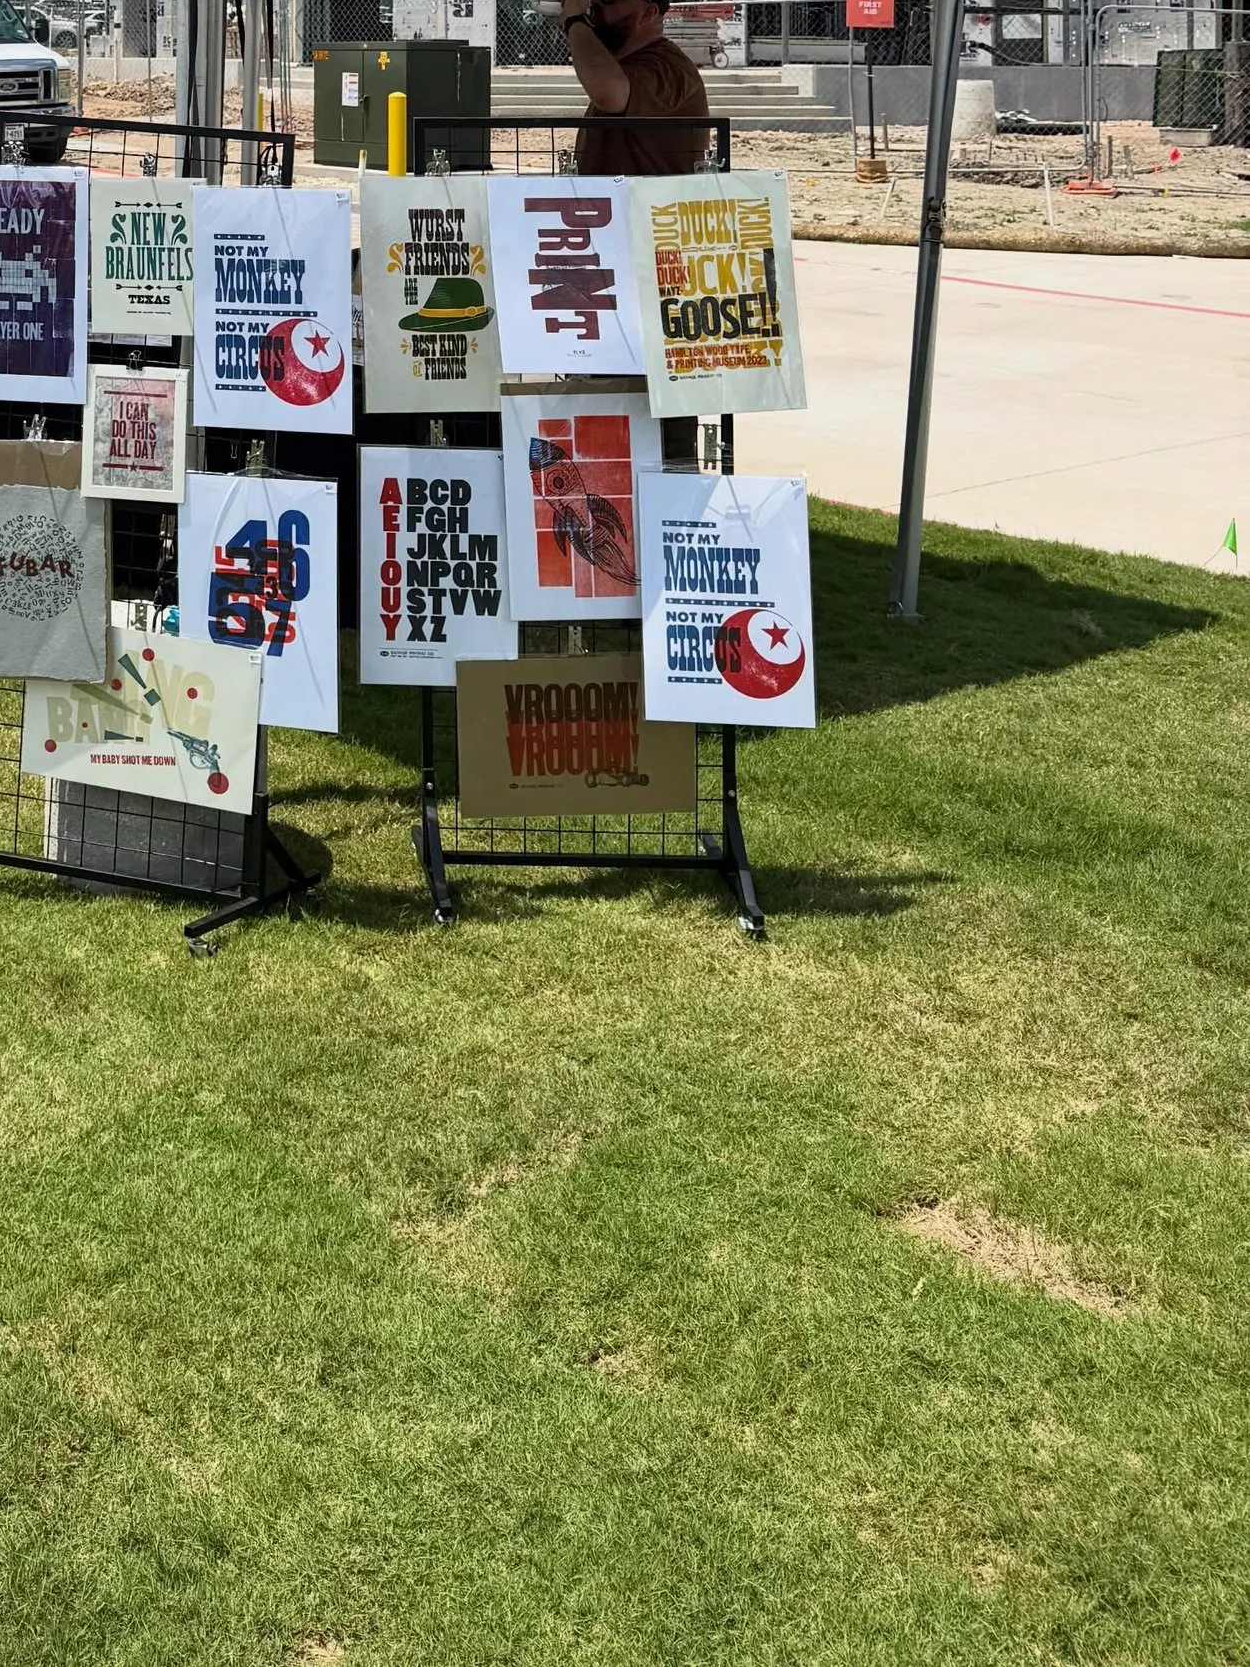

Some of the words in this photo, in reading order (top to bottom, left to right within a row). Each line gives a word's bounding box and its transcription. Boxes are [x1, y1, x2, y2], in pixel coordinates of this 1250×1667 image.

[130, 212, 168, 245] NEW
[408, 208, 465, 241] WURST
[105, 246, 194, 281] BRAUNFELS
[214, 245, 244, 257] NOT
[247, 246, 268, 257] MY
[404, 242, 470, 276] FRIENDS
[215, 259, 306, 305] MONKEY
[524, 198, 617, 340] PRINT
[128, 294, 170, 304] TEXAS
[404, 291, 419, 305] THE
[23, 322, 44, 341] ONE
[215, 321, 245, 332] NOT
[248, 322, 269, 333] MY
[215, 334, 285, 381] CIRCUS
[412, 334, 437, 357] BEST
[439, 334, 467, 357] KIND
[424, 357, 467, 380] FRIENDS
[119, 401, 125, 420] I
[126, 401, 149, 421] CAN
[112, 421, 127, 439] DO
[129, 421, 157, 440] THIS
[109, 441, 131, 458] ALL
[133, 441, 157, 460] DAY
[379, 478, 402, 504] A
[406, 479, 471, 505] BCD
[383, 506, 400, 532] E
[406, 506, 468, 533] FGH
[407, 534, 498, 561] JKLM
[663, 532, 694, 544] NOT
[698, 533, 720, 545] MY
[380, 561, 402, 586] O
[406, 561, 497, 588] NPQR
[664, 546, 760, 595] MONKEY
[381, 588, 401, 614] U
[406, 588, 502, 617] STVW
[379, 614, 402, 641] Y
[406, 615, 447, 643] XZ
[666, 611, 698, 623] NOT
[701, 612, 723, 625] MY
[667, 625, 742, 673] CIRCUS
[504, 682, 639, 724] VROOOM!
[90, 754, 101, 764] MY
[102, 754, 120, 765] BABY
[121, 754, 141, 765] SHOT
[141, 754, 152, 766] ME
[153, 755, 176, 766] DOWN
[506, 734, 640, 776] VROOOM!
